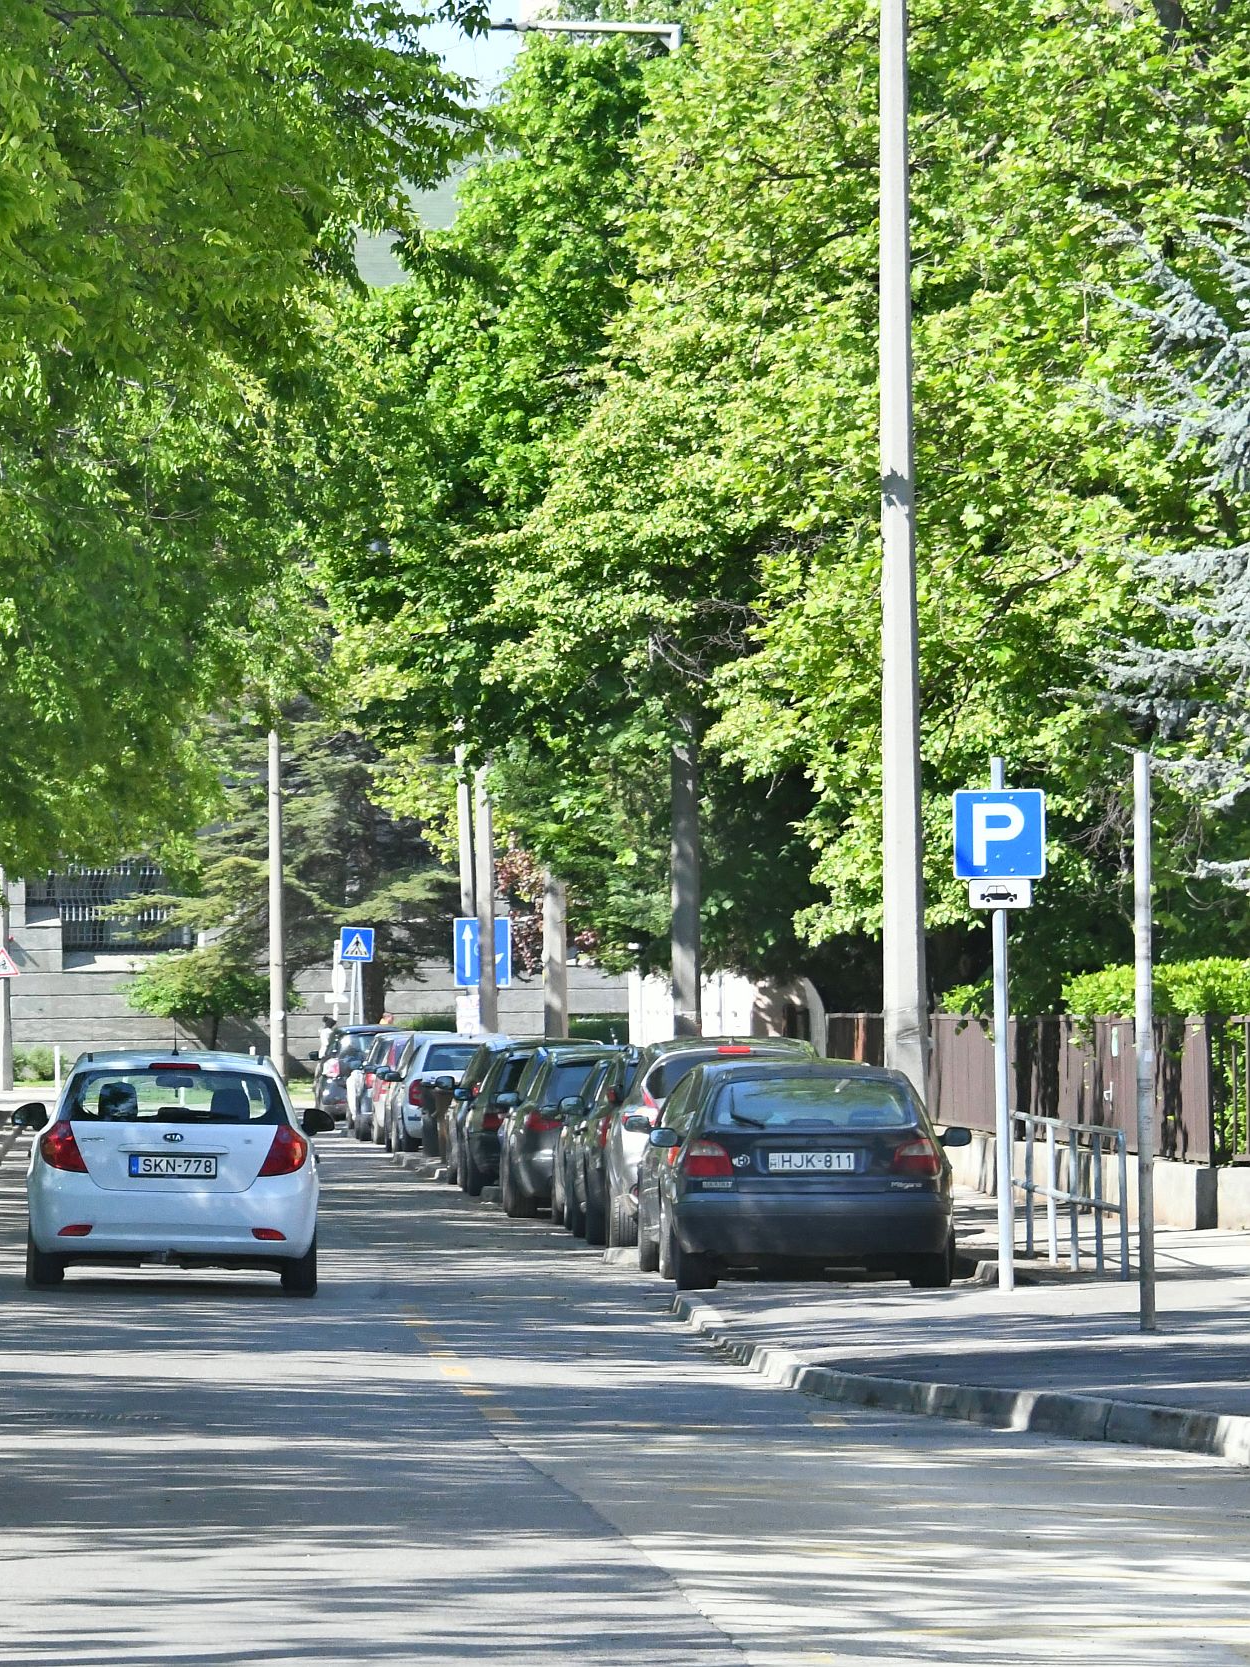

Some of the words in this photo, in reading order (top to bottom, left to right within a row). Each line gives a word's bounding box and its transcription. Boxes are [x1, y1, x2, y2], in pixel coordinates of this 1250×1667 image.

[972, 803, 1025, 867] P
[142, 1158, 212, 1173] SKN-778
[781, 1154, 852, 1169] HJK-811
